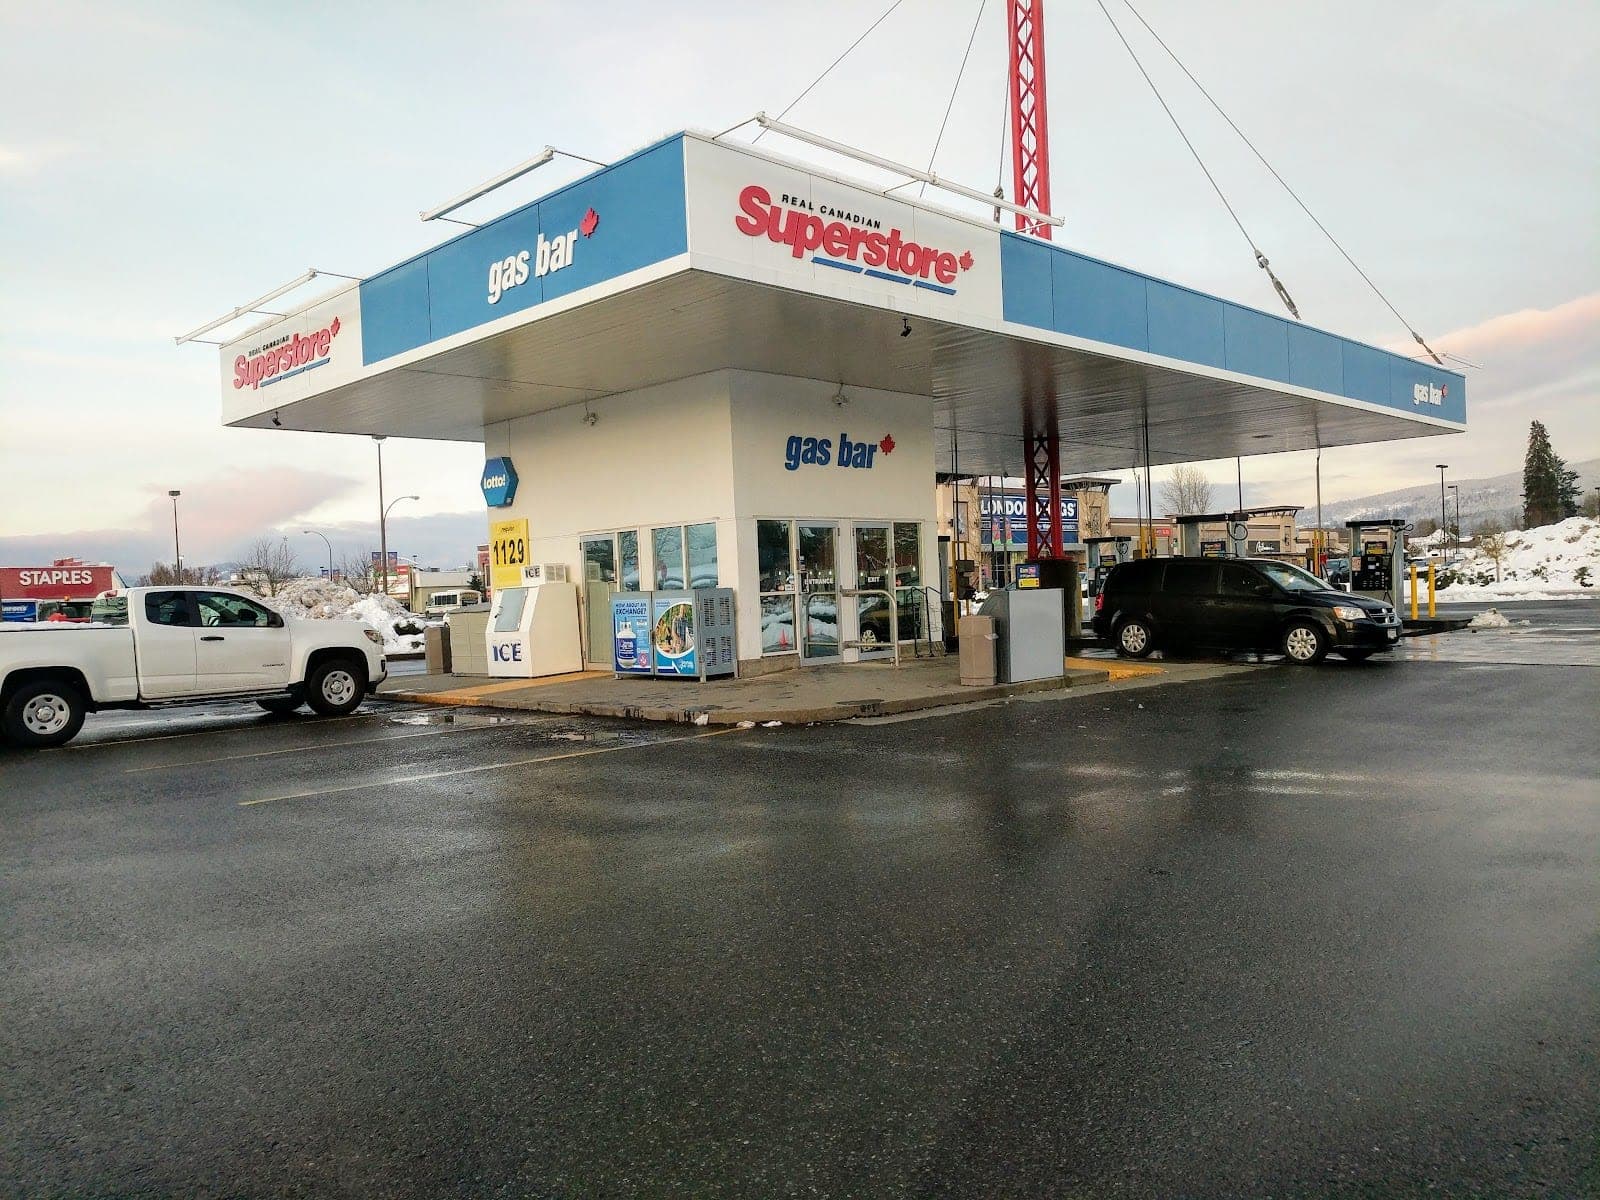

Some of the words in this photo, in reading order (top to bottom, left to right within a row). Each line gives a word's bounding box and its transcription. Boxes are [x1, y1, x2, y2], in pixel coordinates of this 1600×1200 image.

[782, 194, 815, 211] REAL
[820, 205, 881, 229] CANADIAN
[735, 185, 958, 284] Superstore
[487, 250, 531, 305] gas
[535, 228, 579, 278] bar
[248, 347, 262, 357] REAL
[262, 334, 290, 351] CANADIAN
[233, 328, 332, 391] Superstore
[1413, 383, 1429, 406] gas
[1429, 382, 1443, 407] bar
[784, 435, 832, 471] gas
[837, 433, 878, 469] bar
[19, 569, 93, 586] STAPLES
[525, 567, 541, 579] ICE
[804, 577, 834, 585] ENTRANCE
[492, 642, 522, 662] ICE
